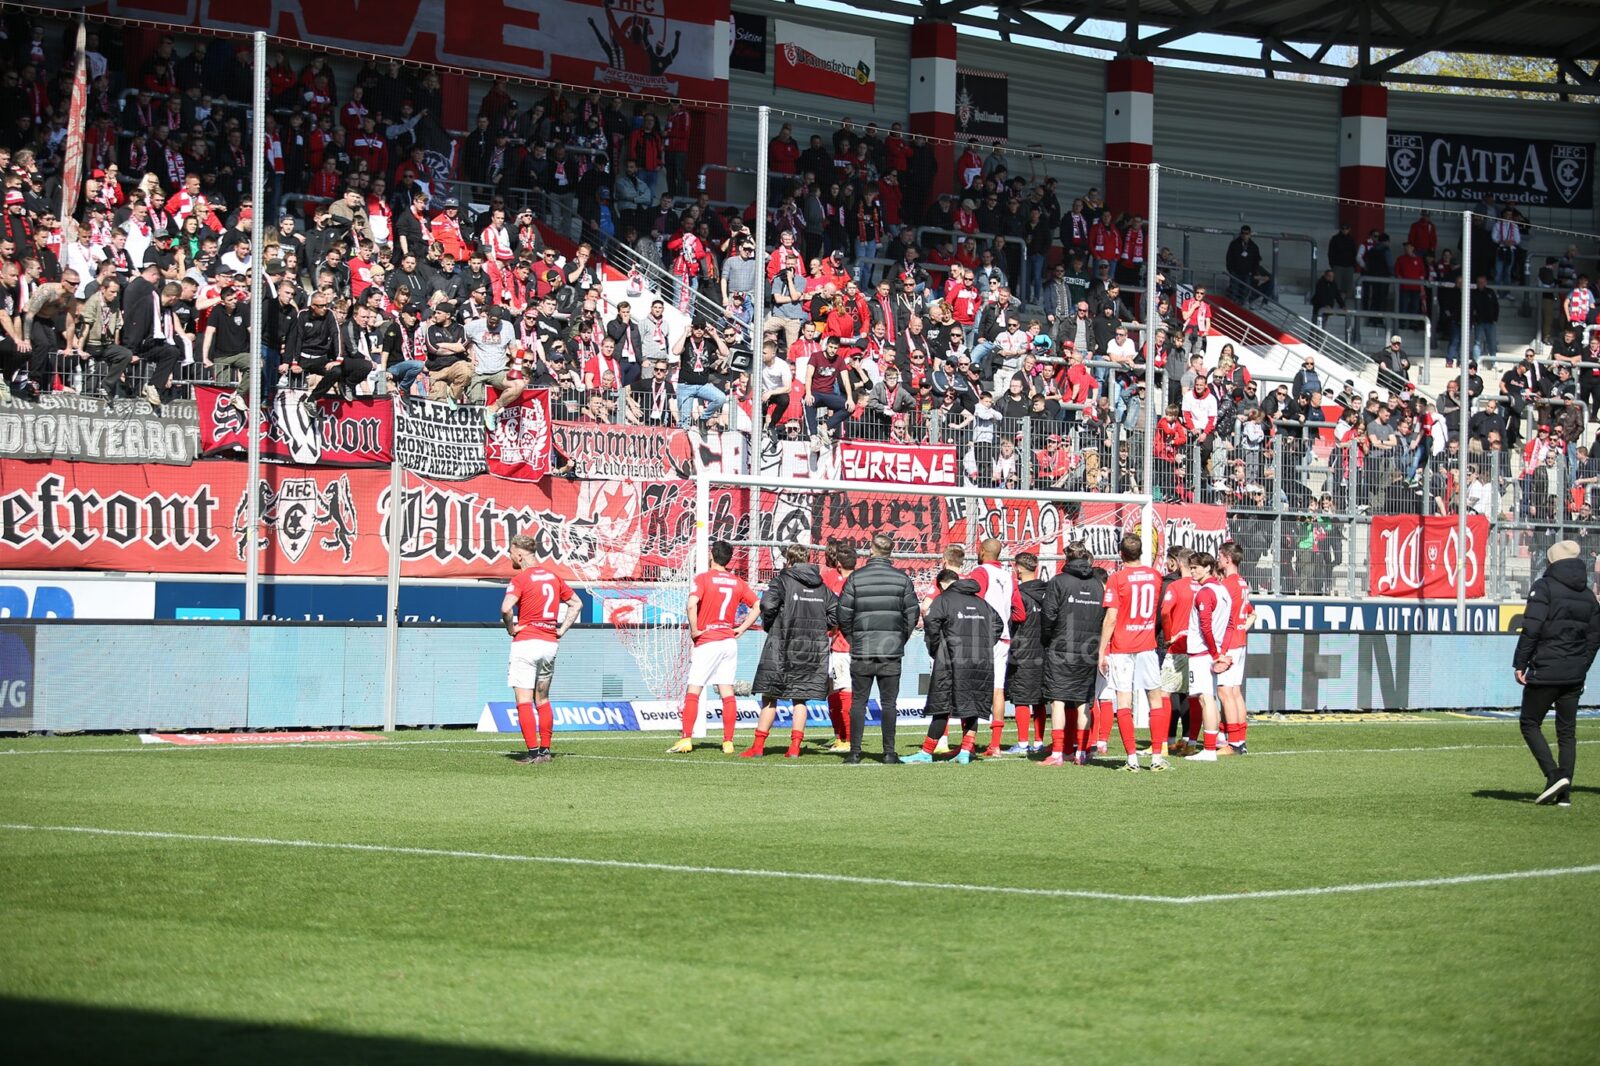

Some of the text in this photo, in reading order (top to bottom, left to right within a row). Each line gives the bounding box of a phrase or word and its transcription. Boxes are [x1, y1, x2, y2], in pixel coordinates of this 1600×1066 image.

[1393, 136, 1417, 147] HFC
[1557, 147, 1580, 157] HFC
[1429, 138, 1549, 193] GATE A
[1433, 186, 1457, 198] No
[405, 400, 485, 426] ELEKOM
[285, 483, 313, 498] HFC
[542, 583, 554, 618] 2
[718, 586, 733, 621] 7
[1130, 583, 1155, 619] 10
[1375, 606, 1497, 632] AUTOMAION
[714, 708, 759, 721] Rgion
